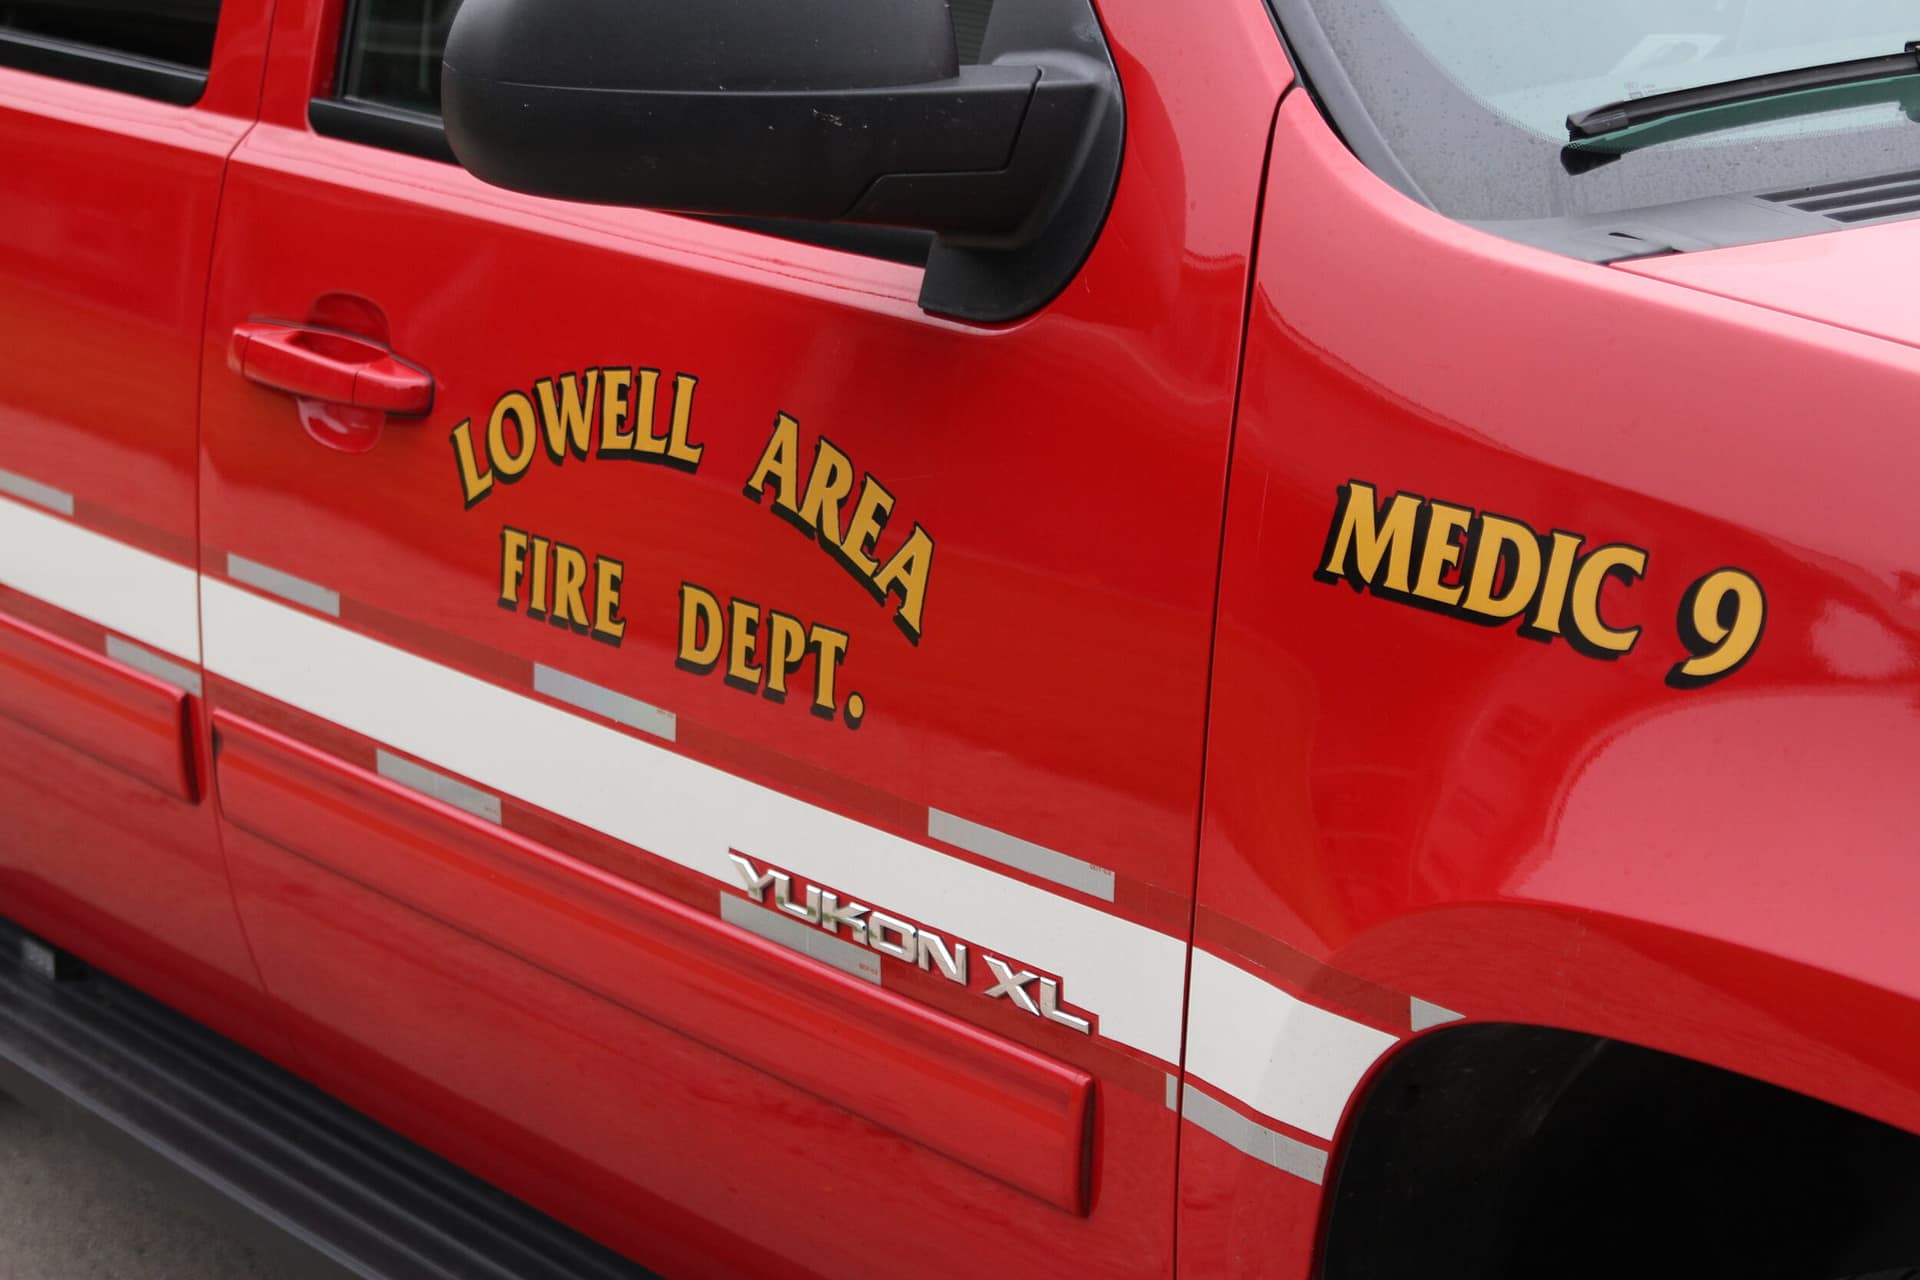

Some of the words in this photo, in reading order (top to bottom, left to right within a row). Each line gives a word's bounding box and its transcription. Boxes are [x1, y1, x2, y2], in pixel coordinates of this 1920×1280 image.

[451, 367, 704, 508] LOWELL
[744, 411, 935, 645] AREA
[1314, 479, 1649, 658] MEDIC
[1666, 566, 1767, 689] 9
[499, 526, 625, 646] FIRE
[676, 581, 866, 729] DEPT.
[728, 851, 968, 986] YUKON
[982, 953, 1091, 1034] XL
